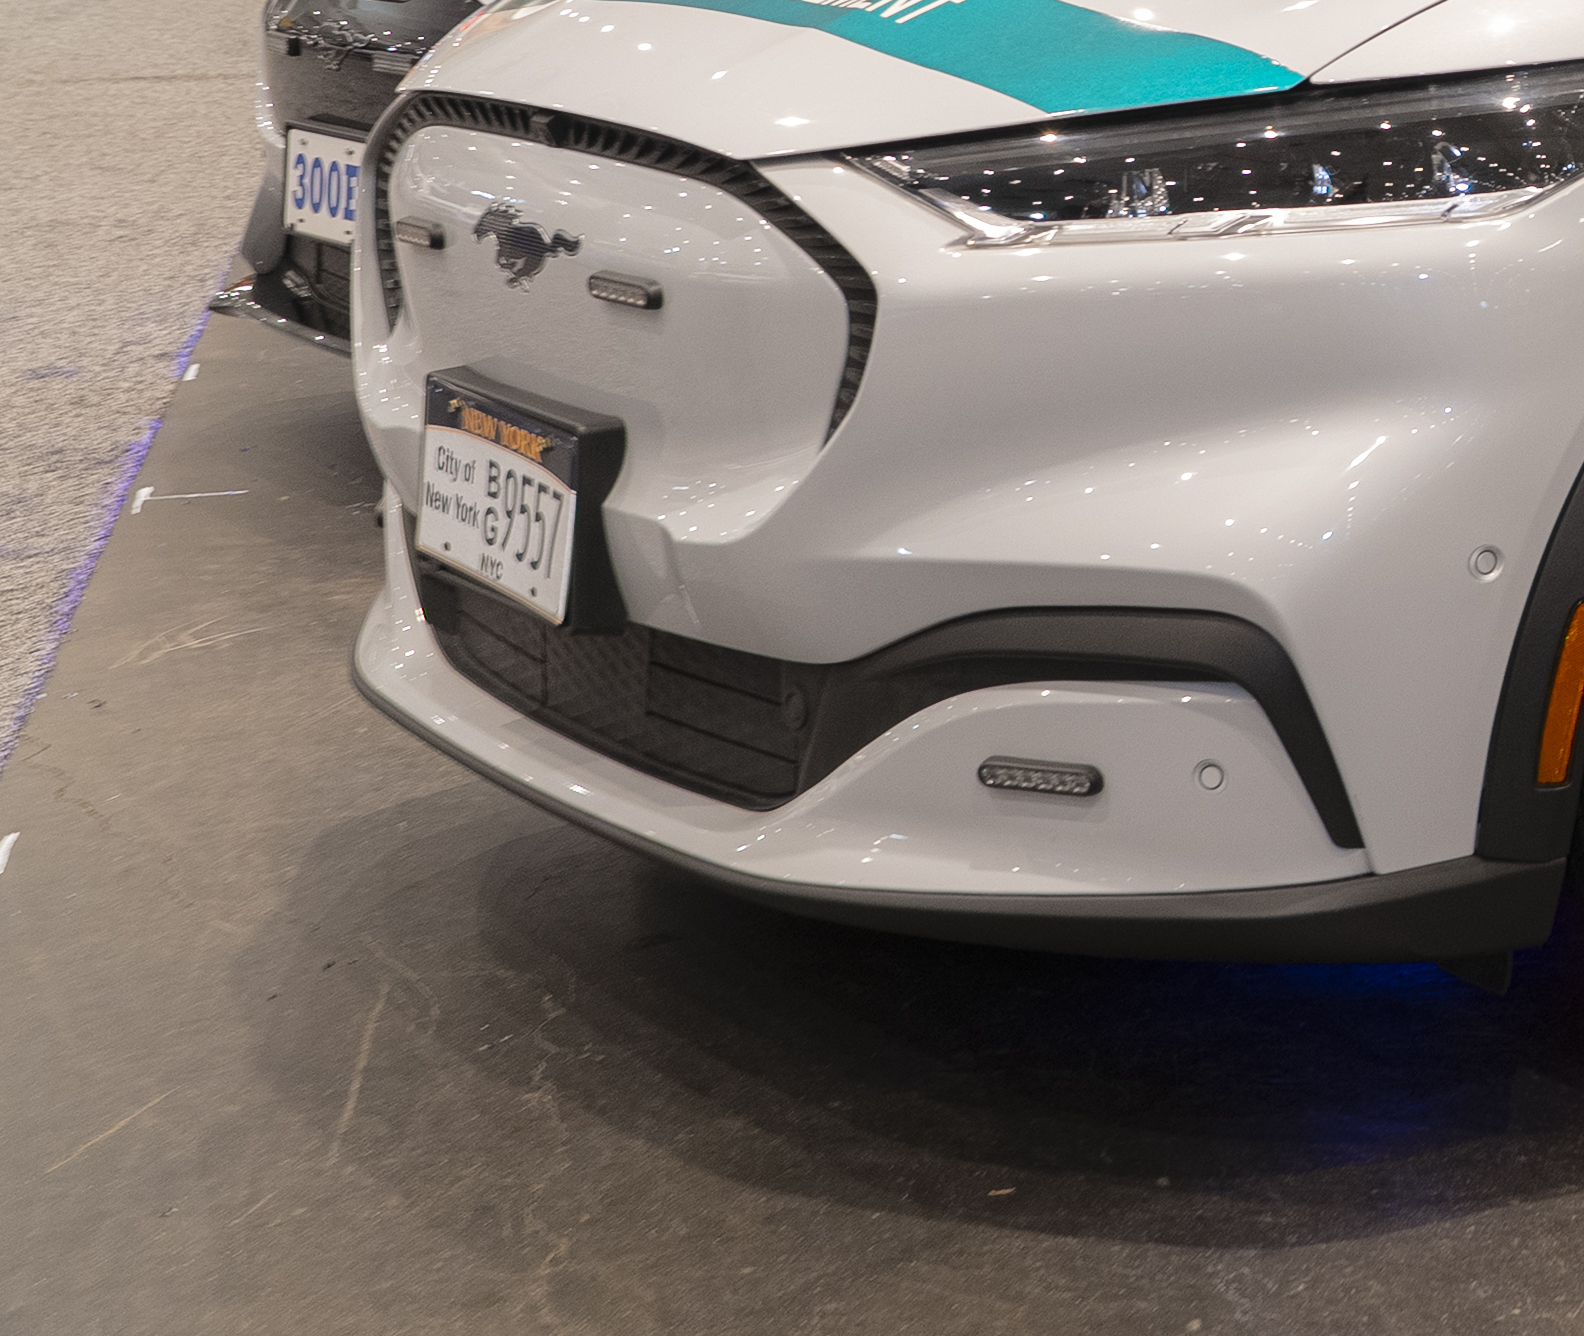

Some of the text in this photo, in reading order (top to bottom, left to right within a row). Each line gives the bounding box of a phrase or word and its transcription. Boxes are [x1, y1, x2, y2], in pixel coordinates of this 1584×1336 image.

[461, 406, 546, 463] NEW YORK
[437, 445, 476, 484] City of
[487, 459, 501, 500] B
[424, 481, 480, 529] New York
[502, 468, 565, 579] 9557
[484, 506, 499, 546] G
[480, 553, 504, 580] NYC
